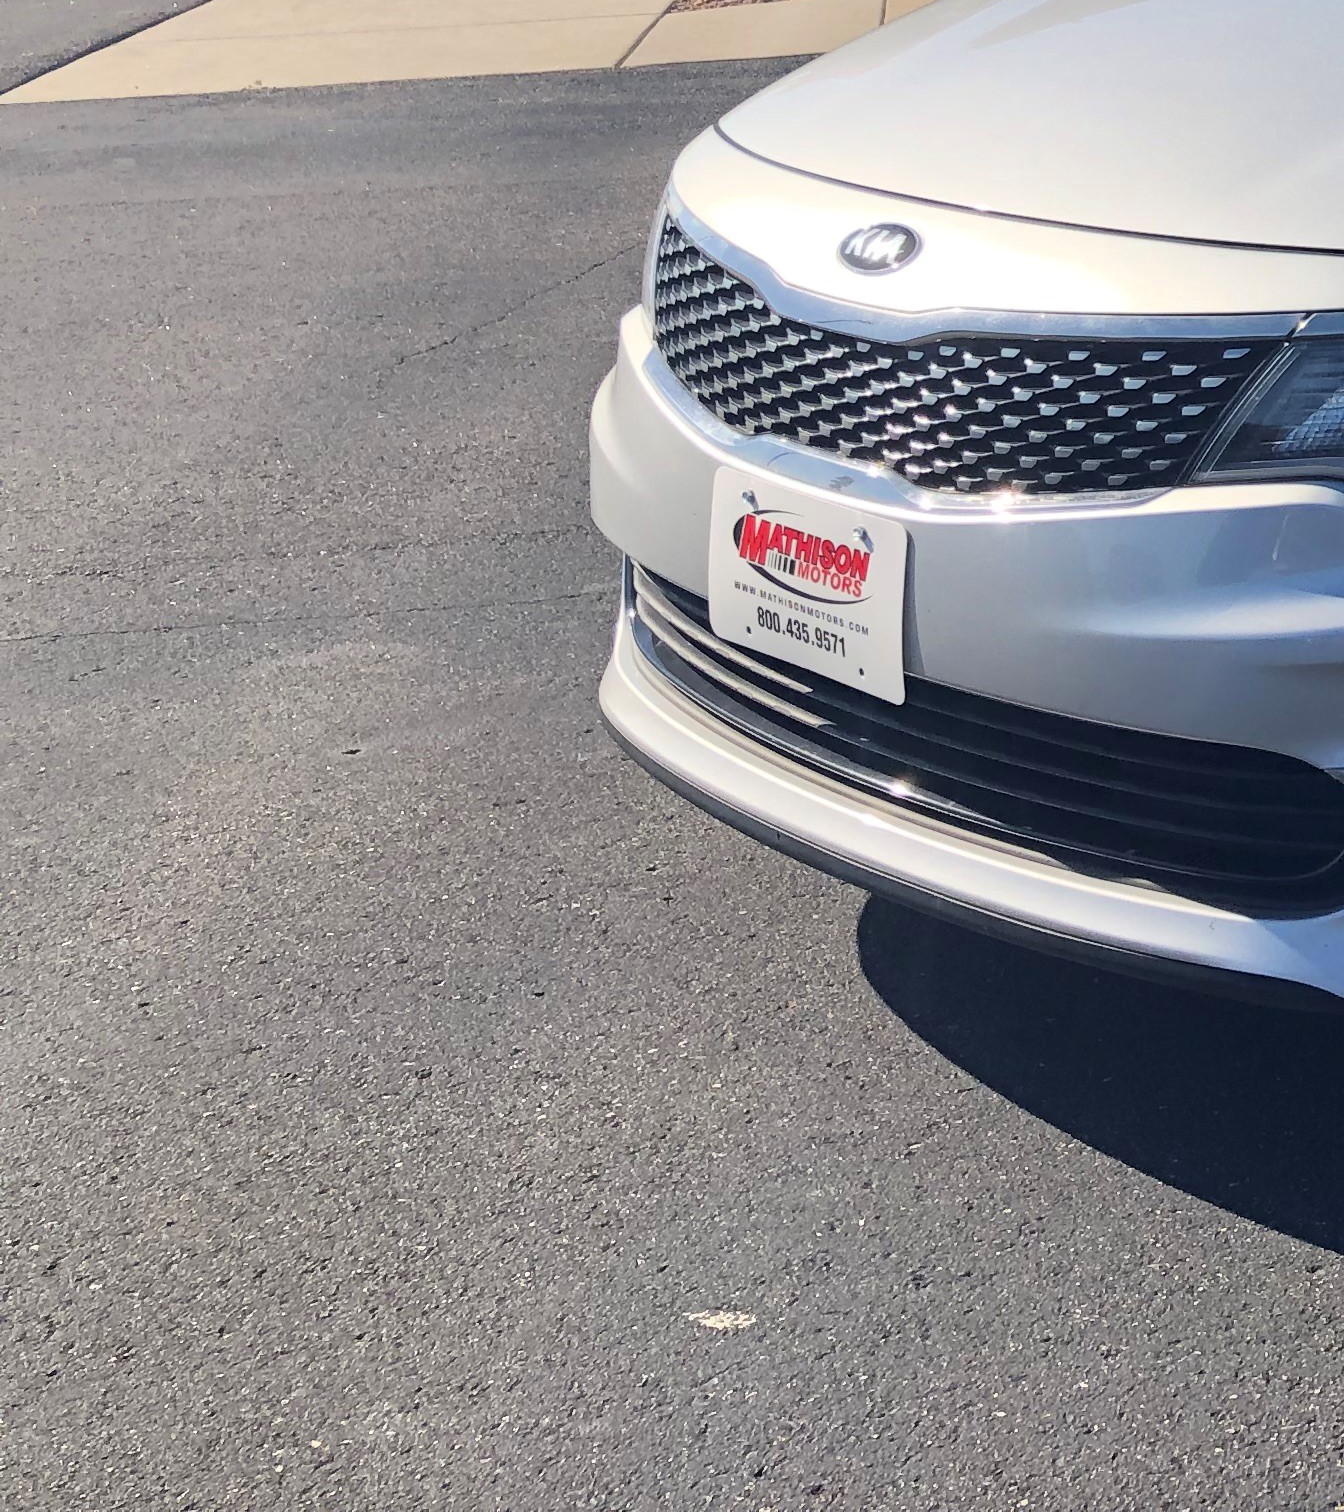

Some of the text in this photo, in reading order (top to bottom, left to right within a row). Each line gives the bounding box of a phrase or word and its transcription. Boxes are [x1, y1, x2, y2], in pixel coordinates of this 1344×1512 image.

[739, 513, 871, 583] MATHISON
[797, 560, 863, 598] MOTORS
[757, 606, 846, 658] 800.435.9571
